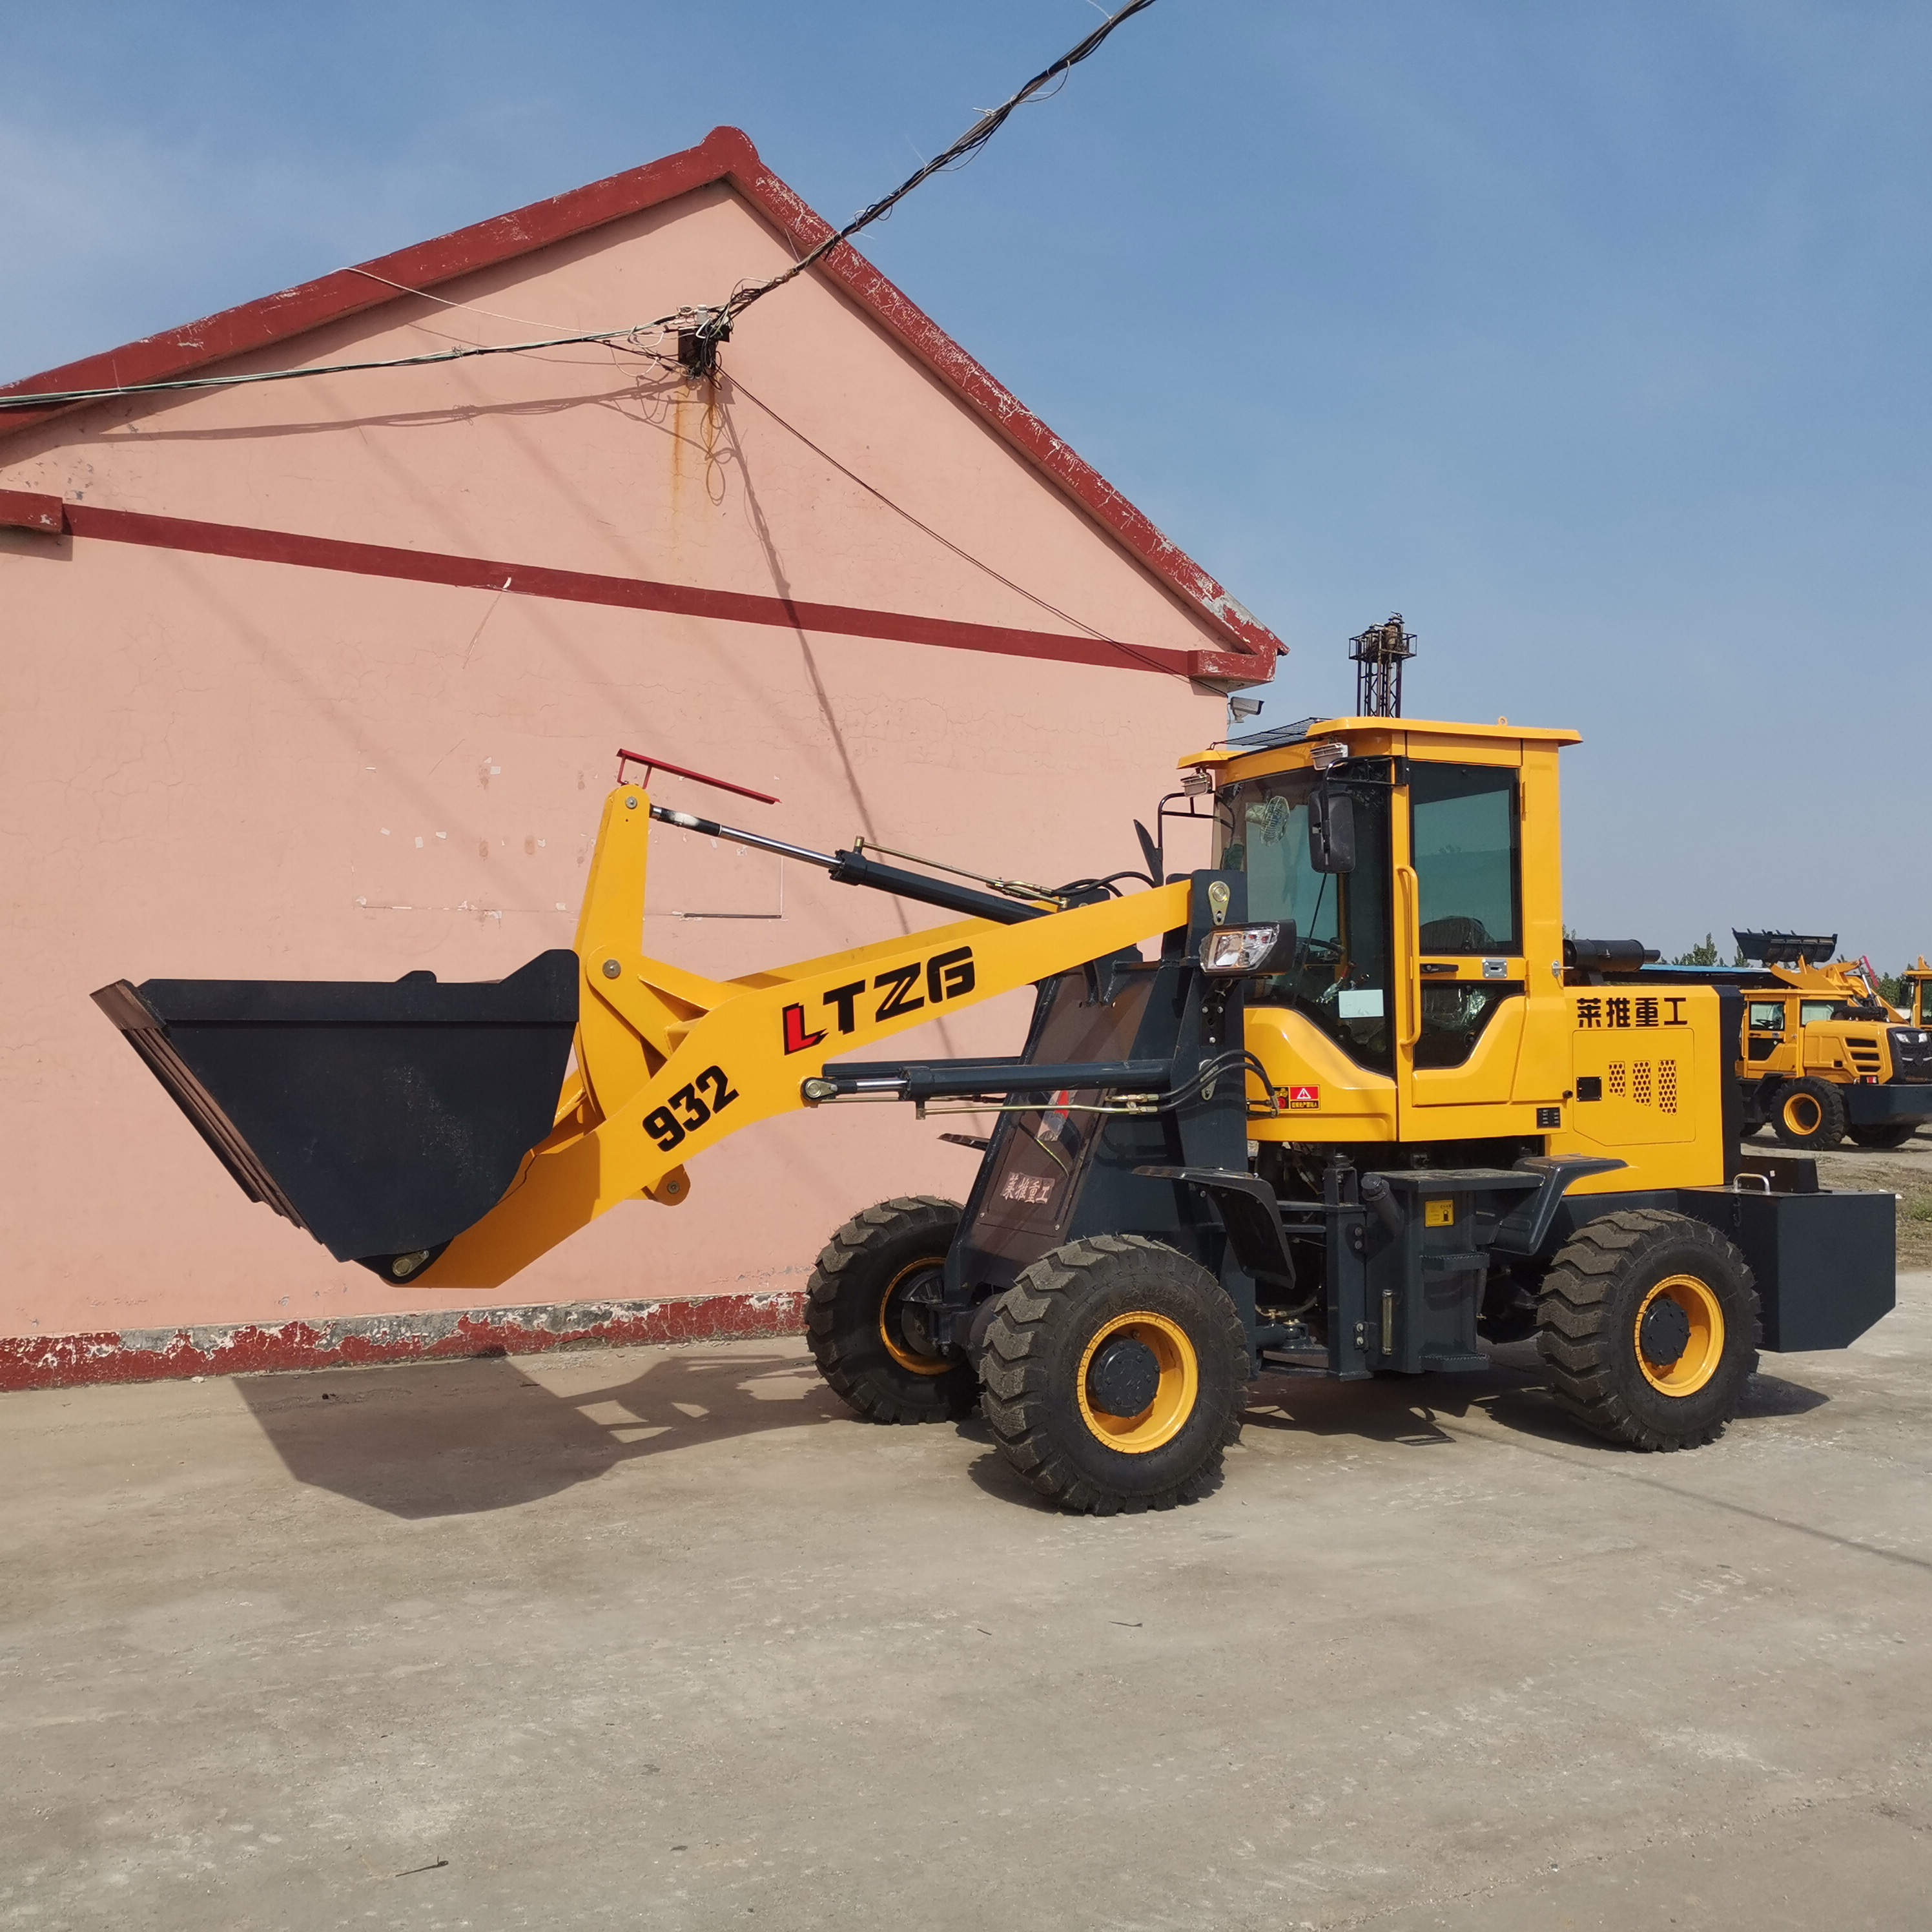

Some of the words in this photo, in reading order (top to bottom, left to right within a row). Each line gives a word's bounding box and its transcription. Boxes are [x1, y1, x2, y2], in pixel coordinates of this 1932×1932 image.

[782, 946, 976, 1055] LTZG
[1576, 997, 1688, 1028] 莱推重工
[642, 1065, 739, 1152] 932
